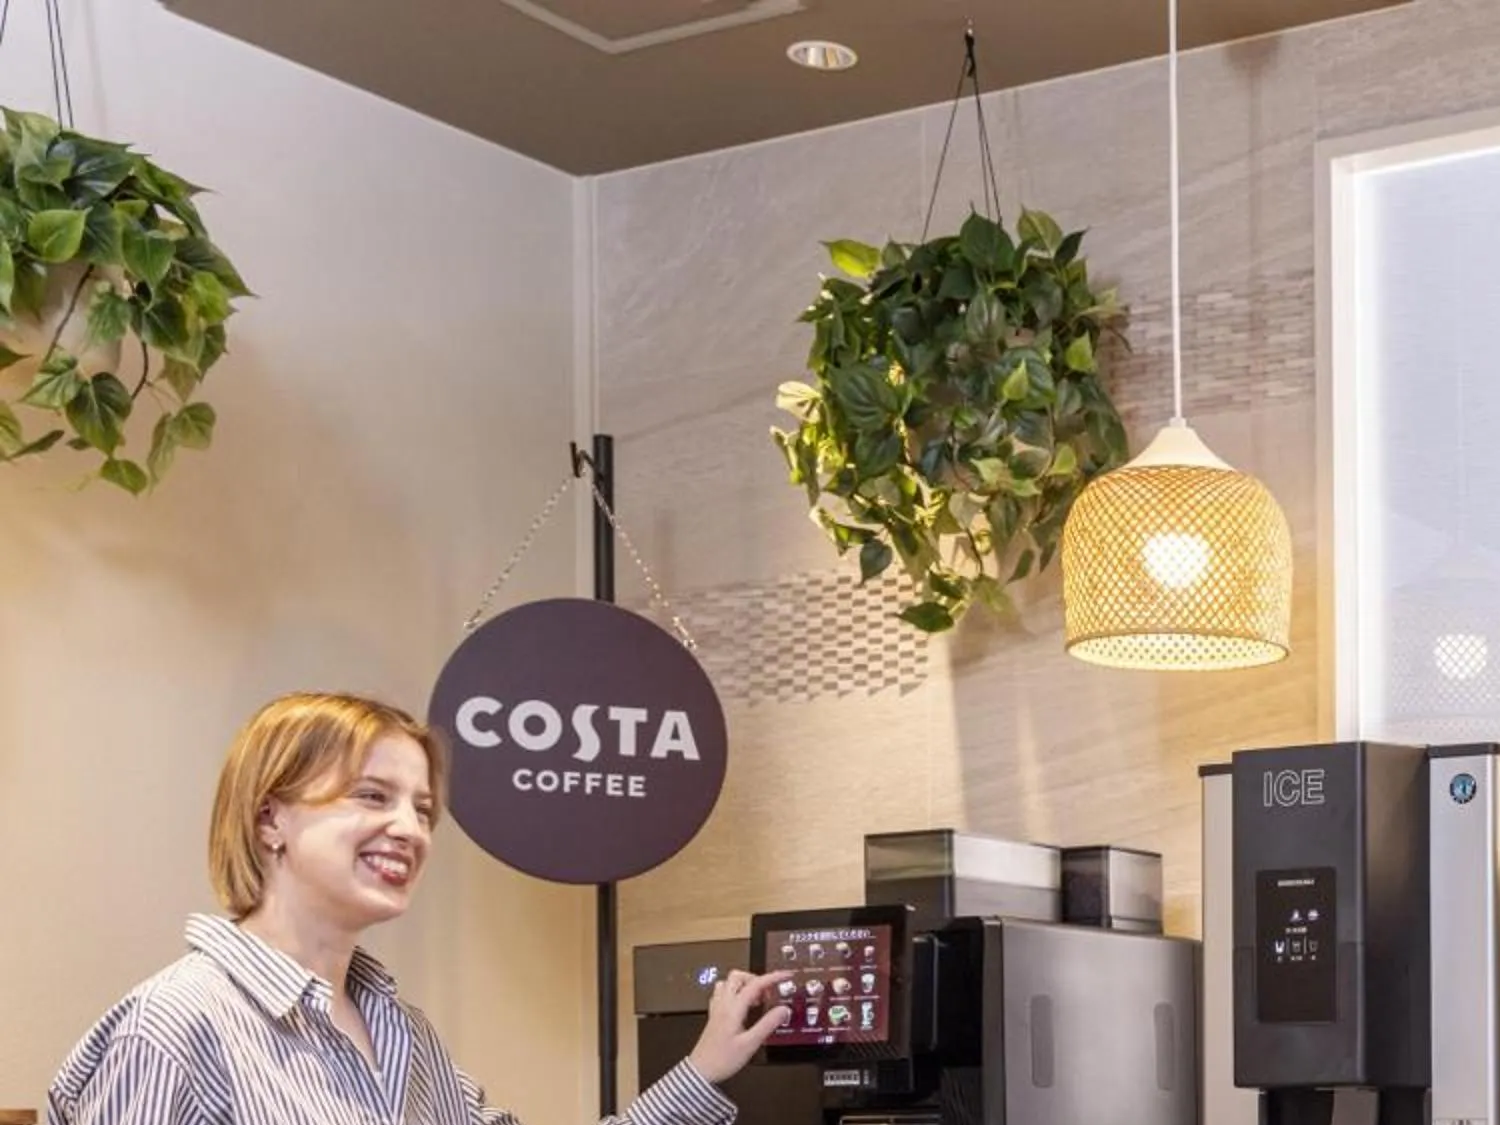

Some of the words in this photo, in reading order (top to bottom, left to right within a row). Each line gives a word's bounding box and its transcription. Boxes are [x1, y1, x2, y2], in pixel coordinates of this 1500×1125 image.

[455, 696, 701, 763] COSTA
[512, 768, 647, 797] COFFEE
[1263, 768, 1325, 807] ICE
